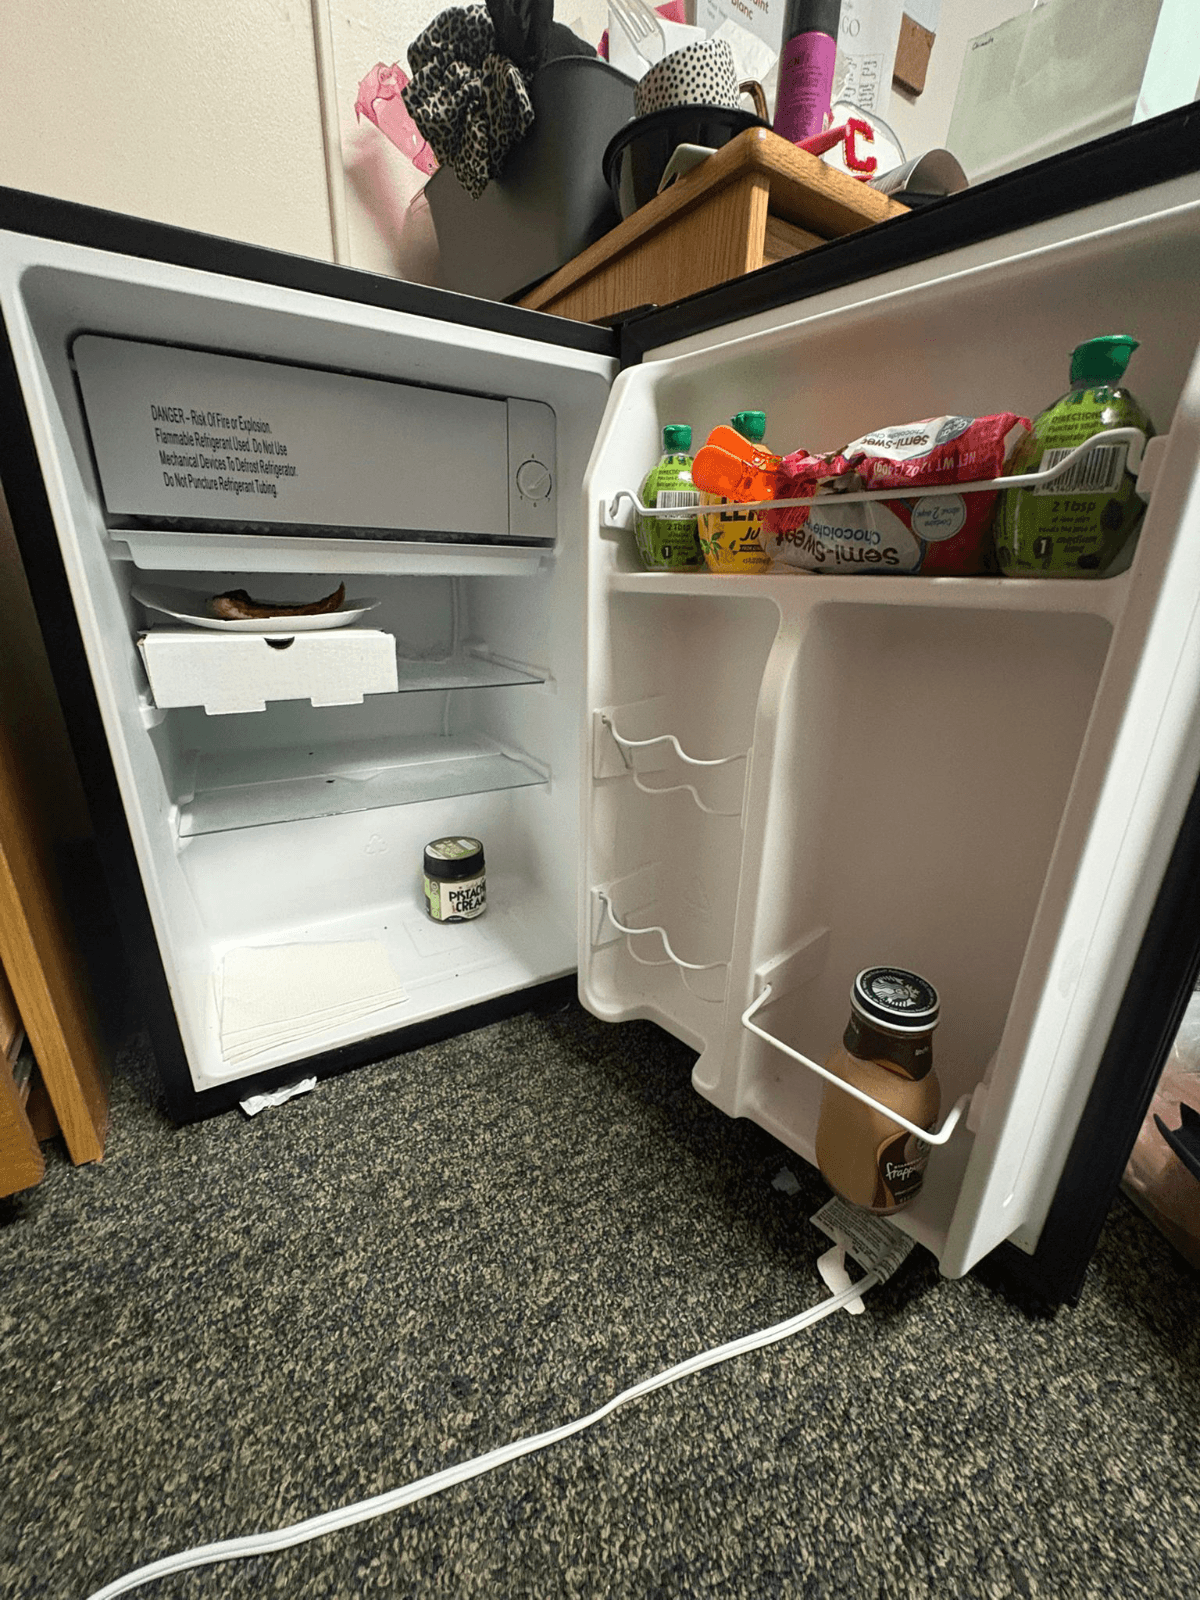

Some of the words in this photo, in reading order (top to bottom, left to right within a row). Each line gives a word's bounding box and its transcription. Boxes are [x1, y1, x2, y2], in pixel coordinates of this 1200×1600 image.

[150, 404, 186, 424] DANGER
[190, 409, 207, 427] Risk
[207, 411, 216, 427] Of
[216, 413, 230, 430] Fire
[231, 418, 238, 430] or
[238, 415, 273, 435] Explosion.
[155, 427, 195, 447] Flammable
[195, 431, 233, 453] Refrigerant
[233, 436, 252, 452] Used.
[252, 438, 262, 454] Do
[262, 440, 275, 456] Not
[274, 442, 288, 456] Use
[159, 450, 199, 469] Mechanical
[199, 453, 226, 471] Devices
[226, 456, 235, 472] To
[235, 457, 260, 474] Defrost
[260, 459, 298, 479] Refrigerator.
[163, 471, 173, 487] Do
[174, 473, 187, 489] Not
[187, 475, 218, 491] Puncture
[218, 476, 255, 495] Refrigerant
[1051, 500, 1060, 512] 2
[813, 522, 881, 545] Chocolate
[1040, 539, 1047, 554] 1
